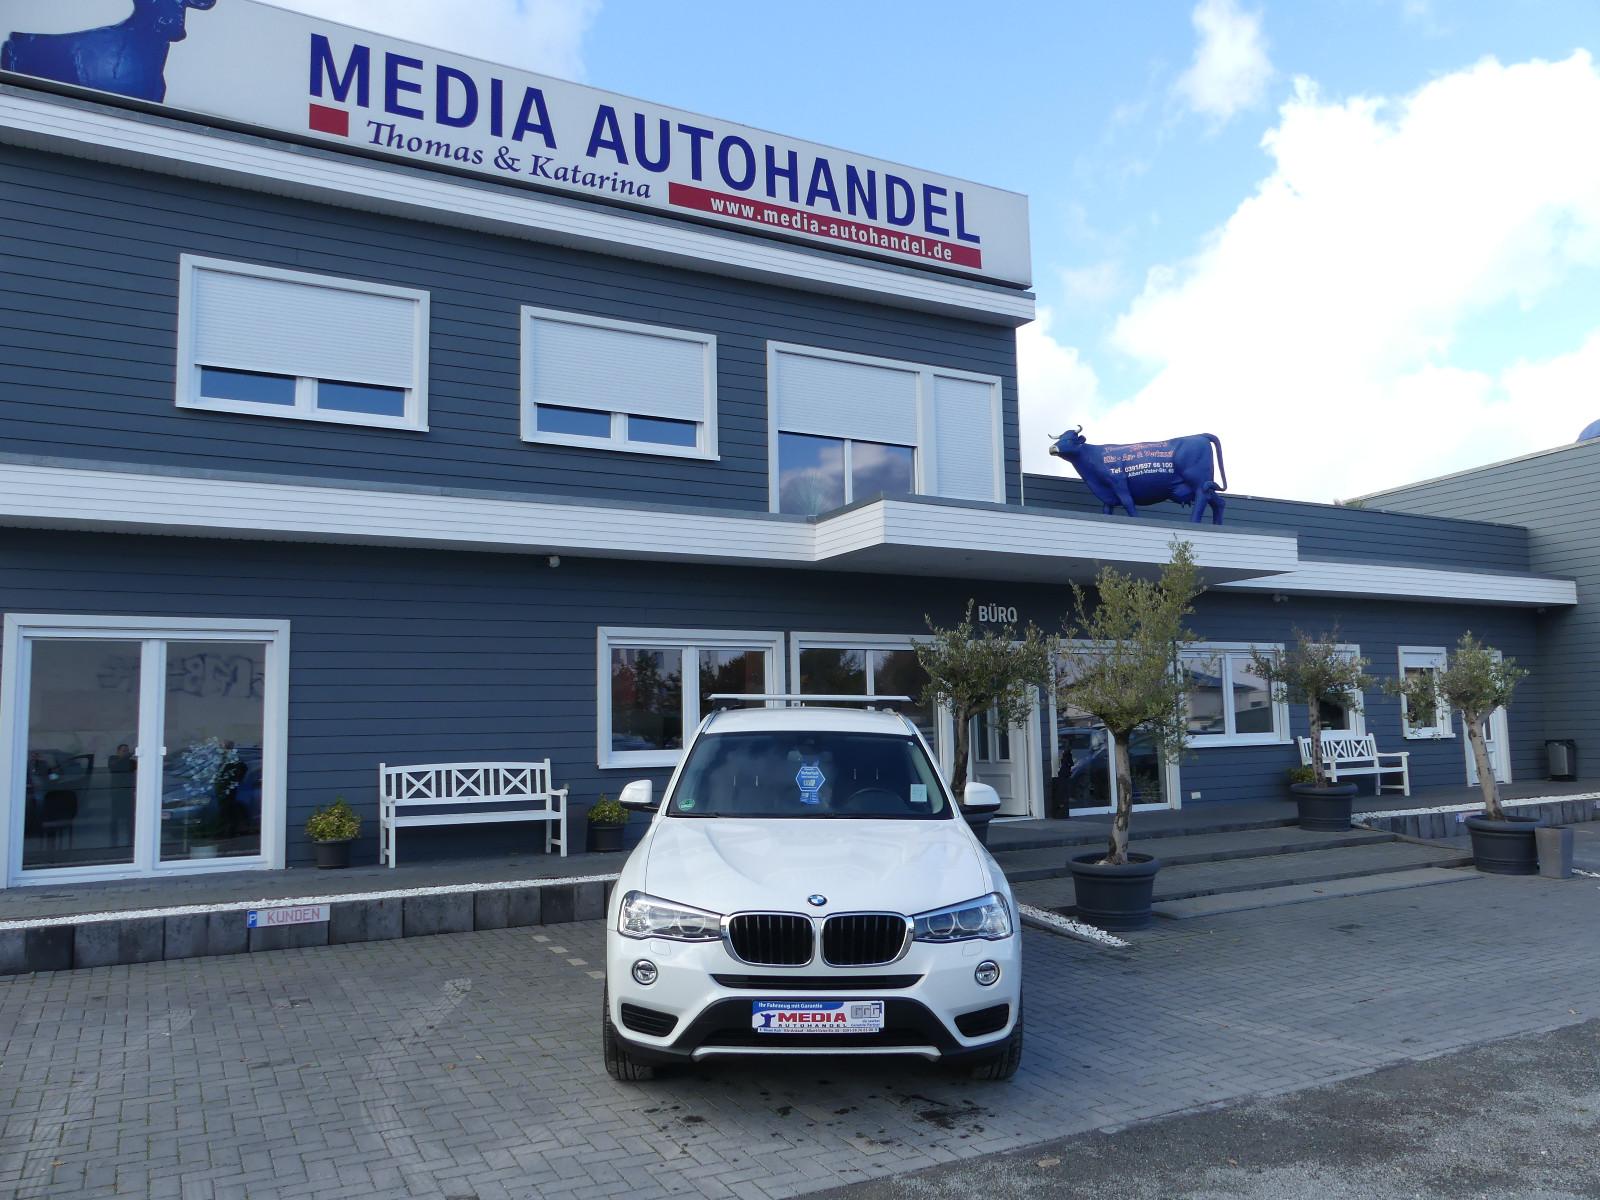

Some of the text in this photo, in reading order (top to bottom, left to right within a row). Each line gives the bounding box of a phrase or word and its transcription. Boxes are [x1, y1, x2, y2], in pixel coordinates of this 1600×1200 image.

[309, 34, 982, 244] MEDIA AUTOHANDEL
[367, 120, 651, 200] Thomas & Katarina
[710, 196, 953, 261] www.media-autohandel.de
[978, 603, 1018, 623] BÜRO
[267, 907, 321, 924] KUNDEN
[778, 1012, 847, 1022] MEDIA
